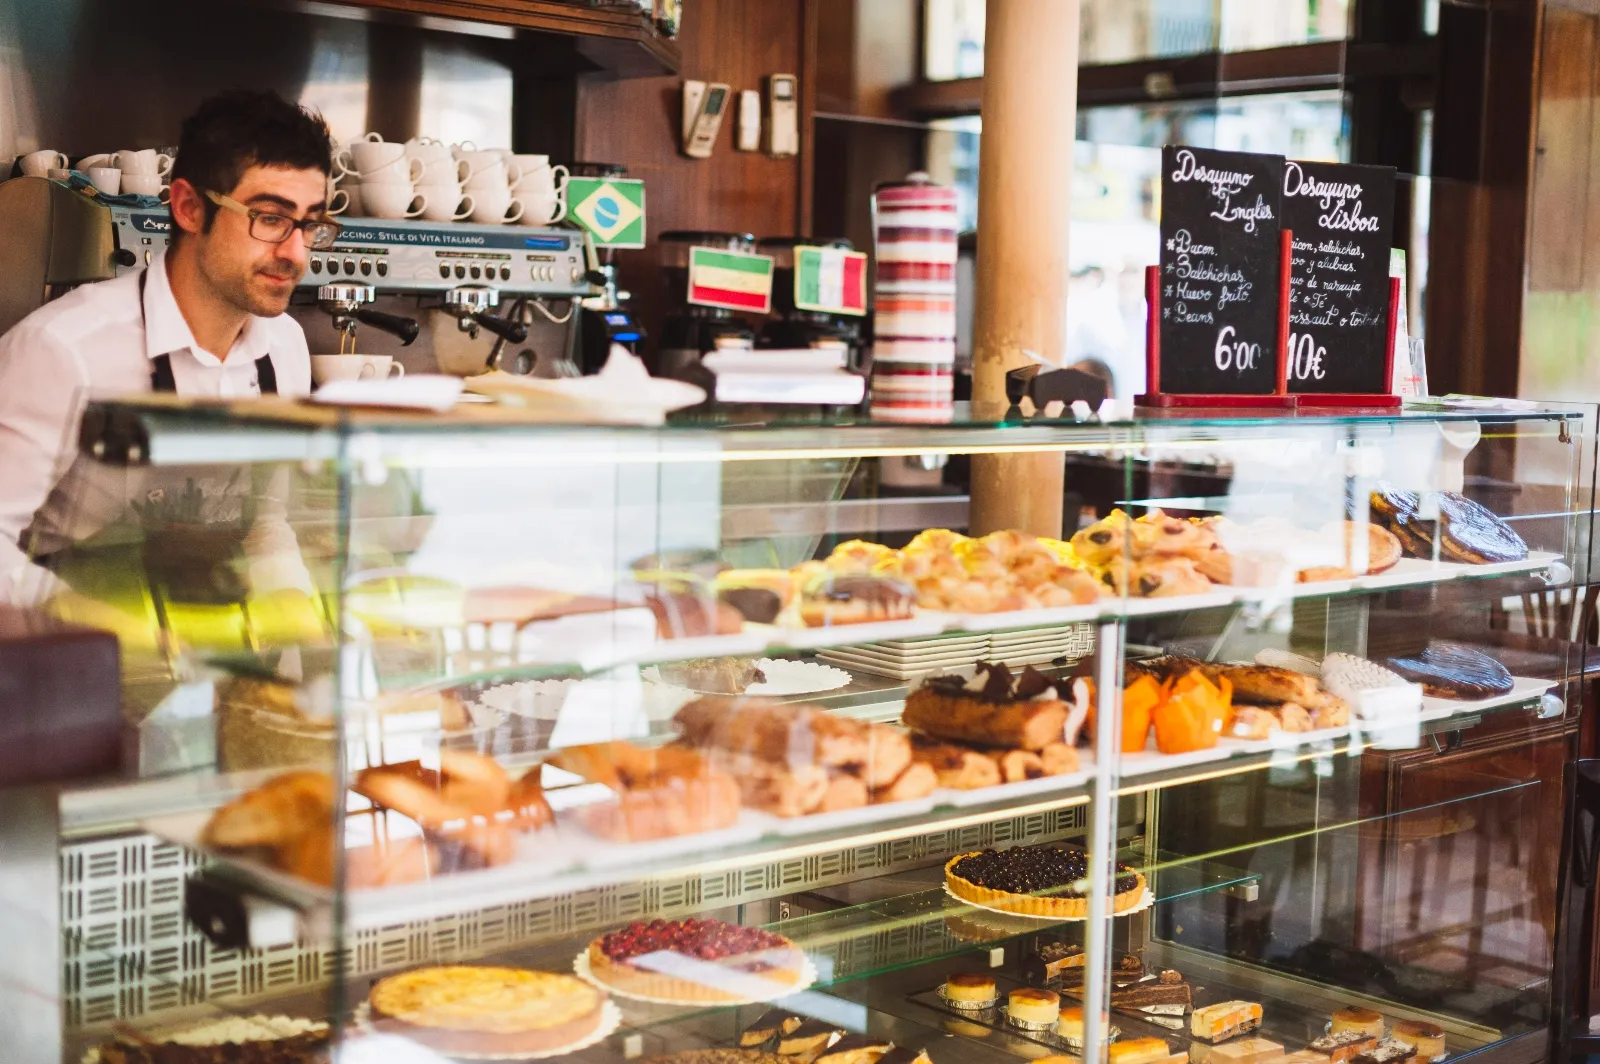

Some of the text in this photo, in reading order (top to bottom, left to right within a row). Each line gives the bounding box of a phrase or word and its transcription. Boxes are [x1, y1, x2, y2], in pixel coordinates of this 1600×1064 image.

[1172, 150, 1254, 199] Desayuno
[1284, 161, 1363, 209] Desayuno
[1318, 199, 1380, 232] Lisboa
[420, 234, 440, 242] VITA
[443, 235, 485, 244] ITALIANO
[1306, 260, 1315, 274] y
[1176, 281, 1213, 301] Huevo
[1307, 274, 1318, 288] de
[1303, 295, 1311, 304] o
[1174, 301, 1214, 325] Beans
[1340, 316, 1348, 327] o
[1286, 332, 1327, 380] 10€
